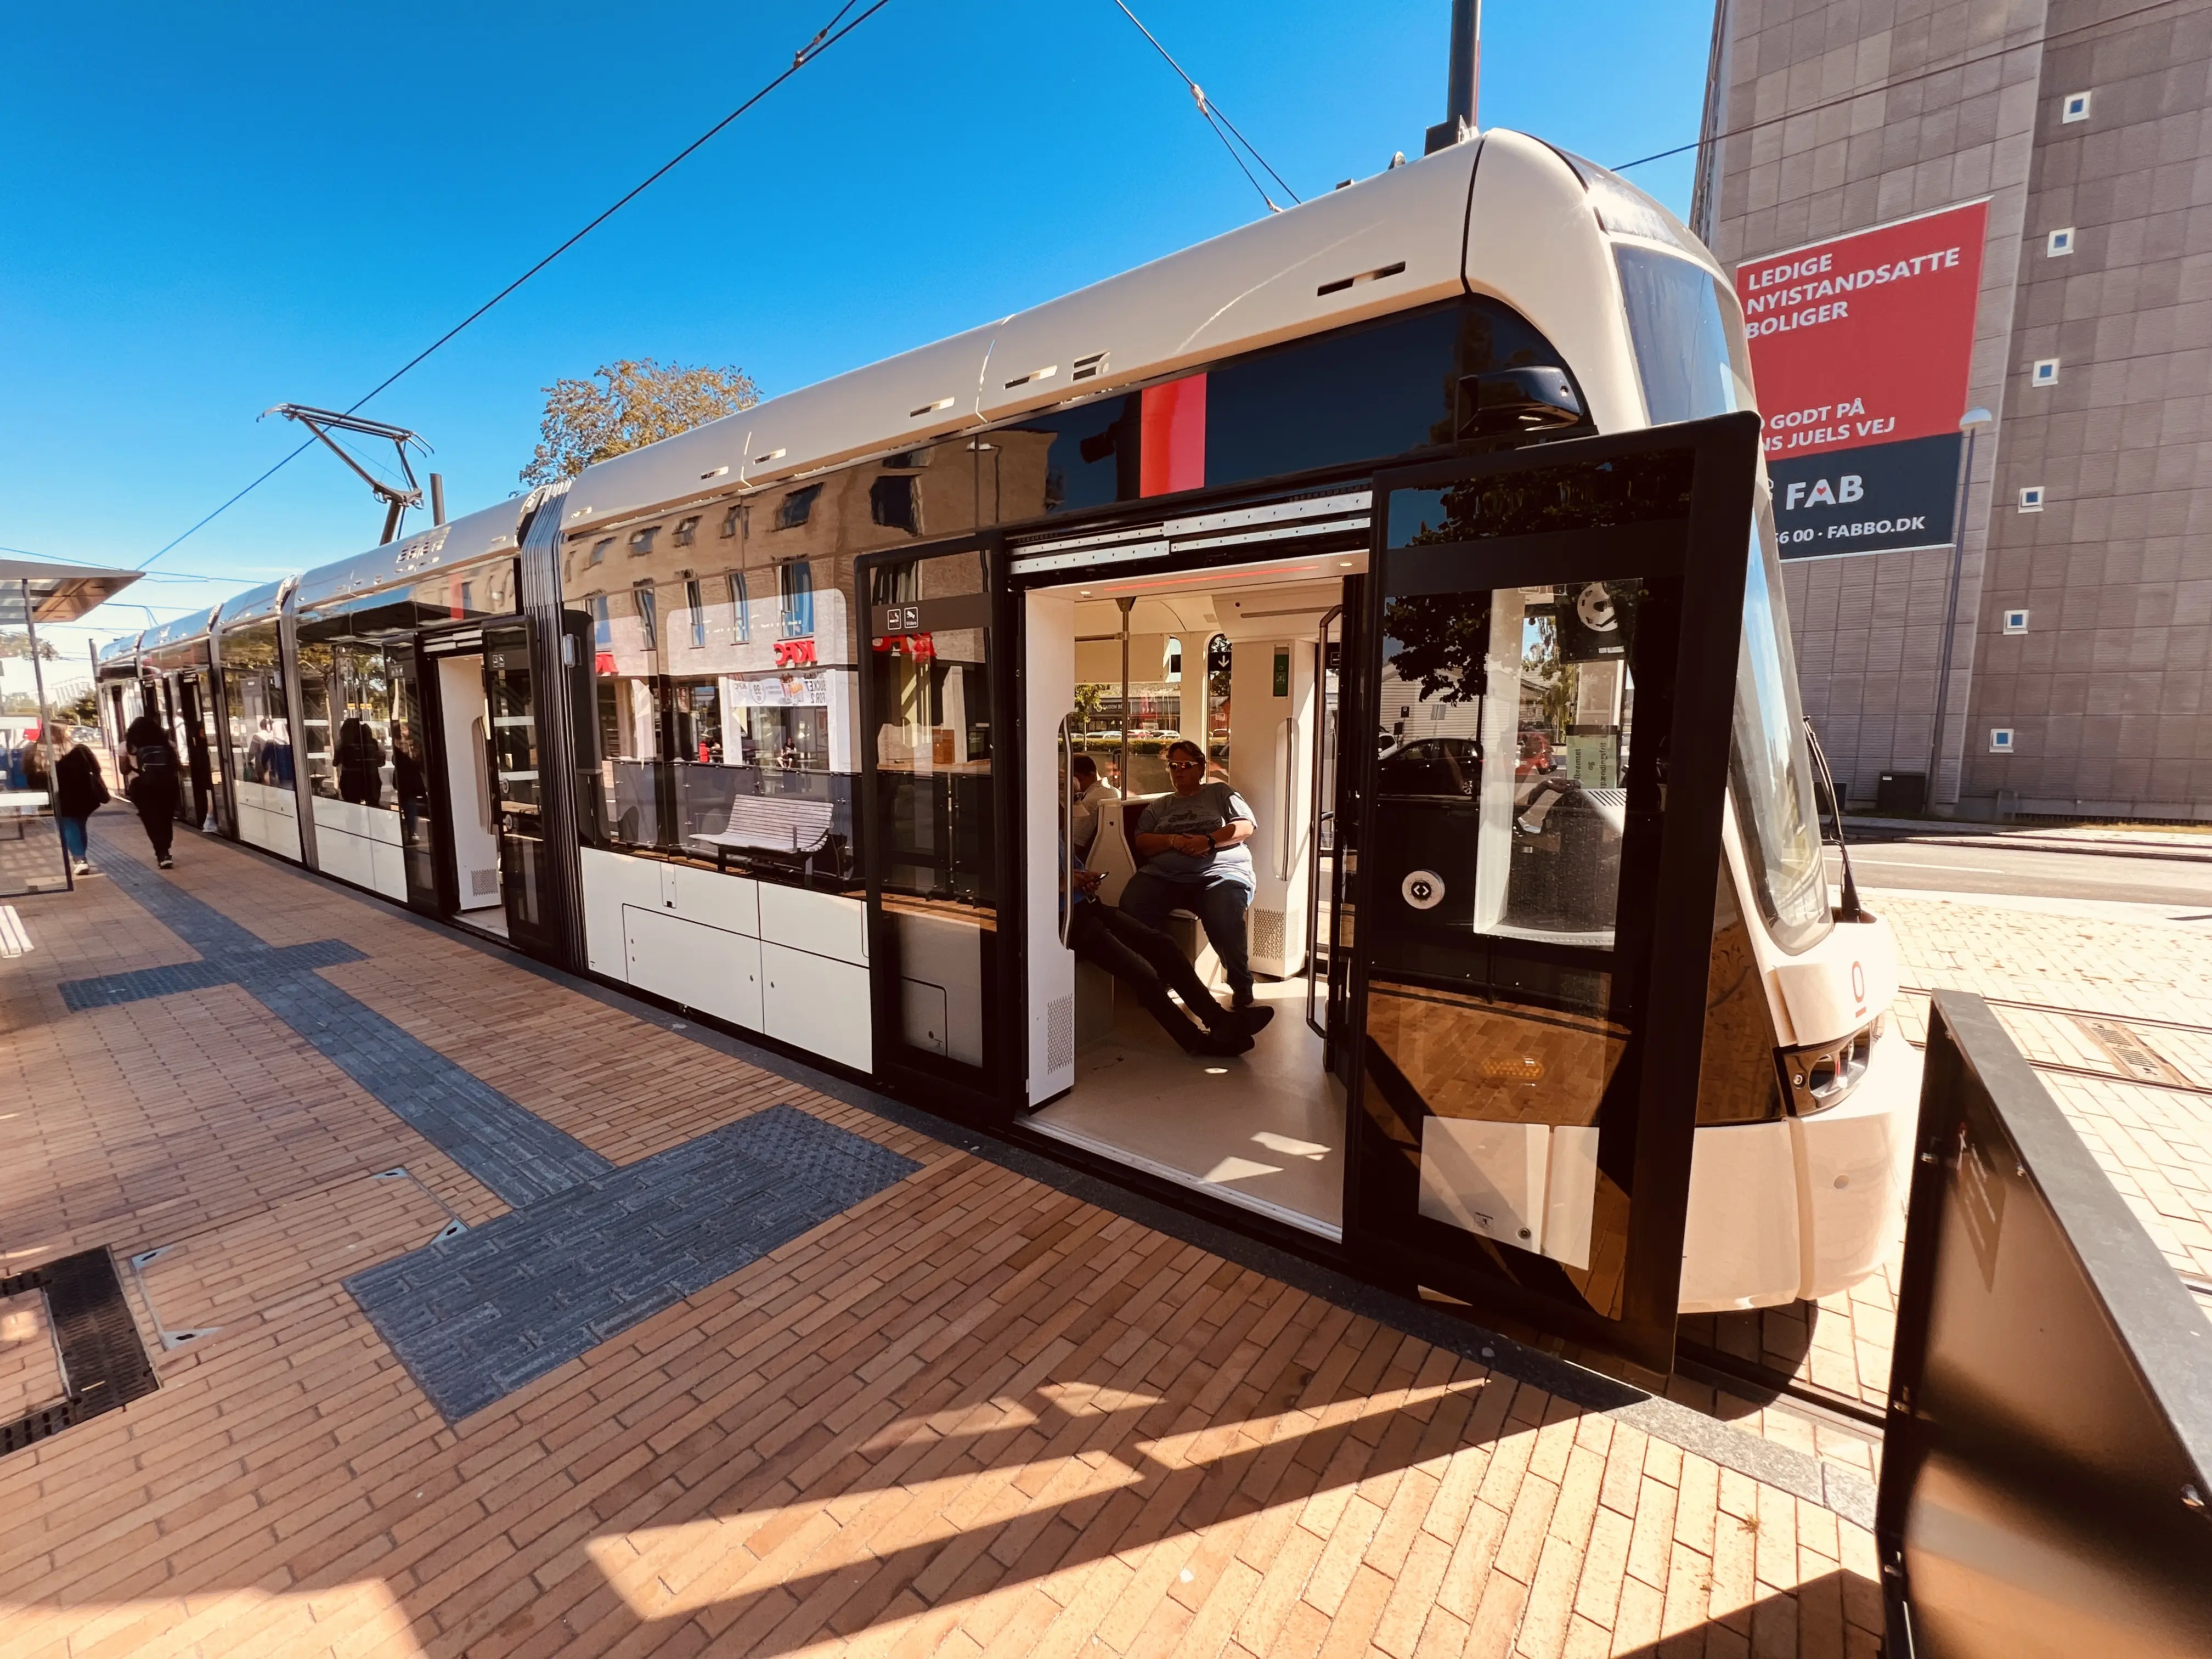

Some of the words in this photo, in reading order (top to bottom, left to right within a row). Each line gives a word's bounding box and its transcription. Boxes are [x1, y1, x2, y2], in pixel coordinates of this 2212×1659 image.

[1747, 247, 1960, 315] NYISTANDSATTE
[1748, 253, 1832, 290] LEDIGE
[1745, 301, 1848, 339] BOLIGER
[1770, 406, 1832, 430] GODT
[1837, 397, 1865, 419] PÅ
[1763, 435, 1783, 451] NS
[1787, 424, 1850, 448] JUELS
[1856, 416, 1895, 435] VEJ
[1785, 475, 1864, 510] FAB
[1792, 528, 1814, 543] 00
[1827, 516, 1926, 539] FABBO.DK
[1588, 761, 1595, 770] og
